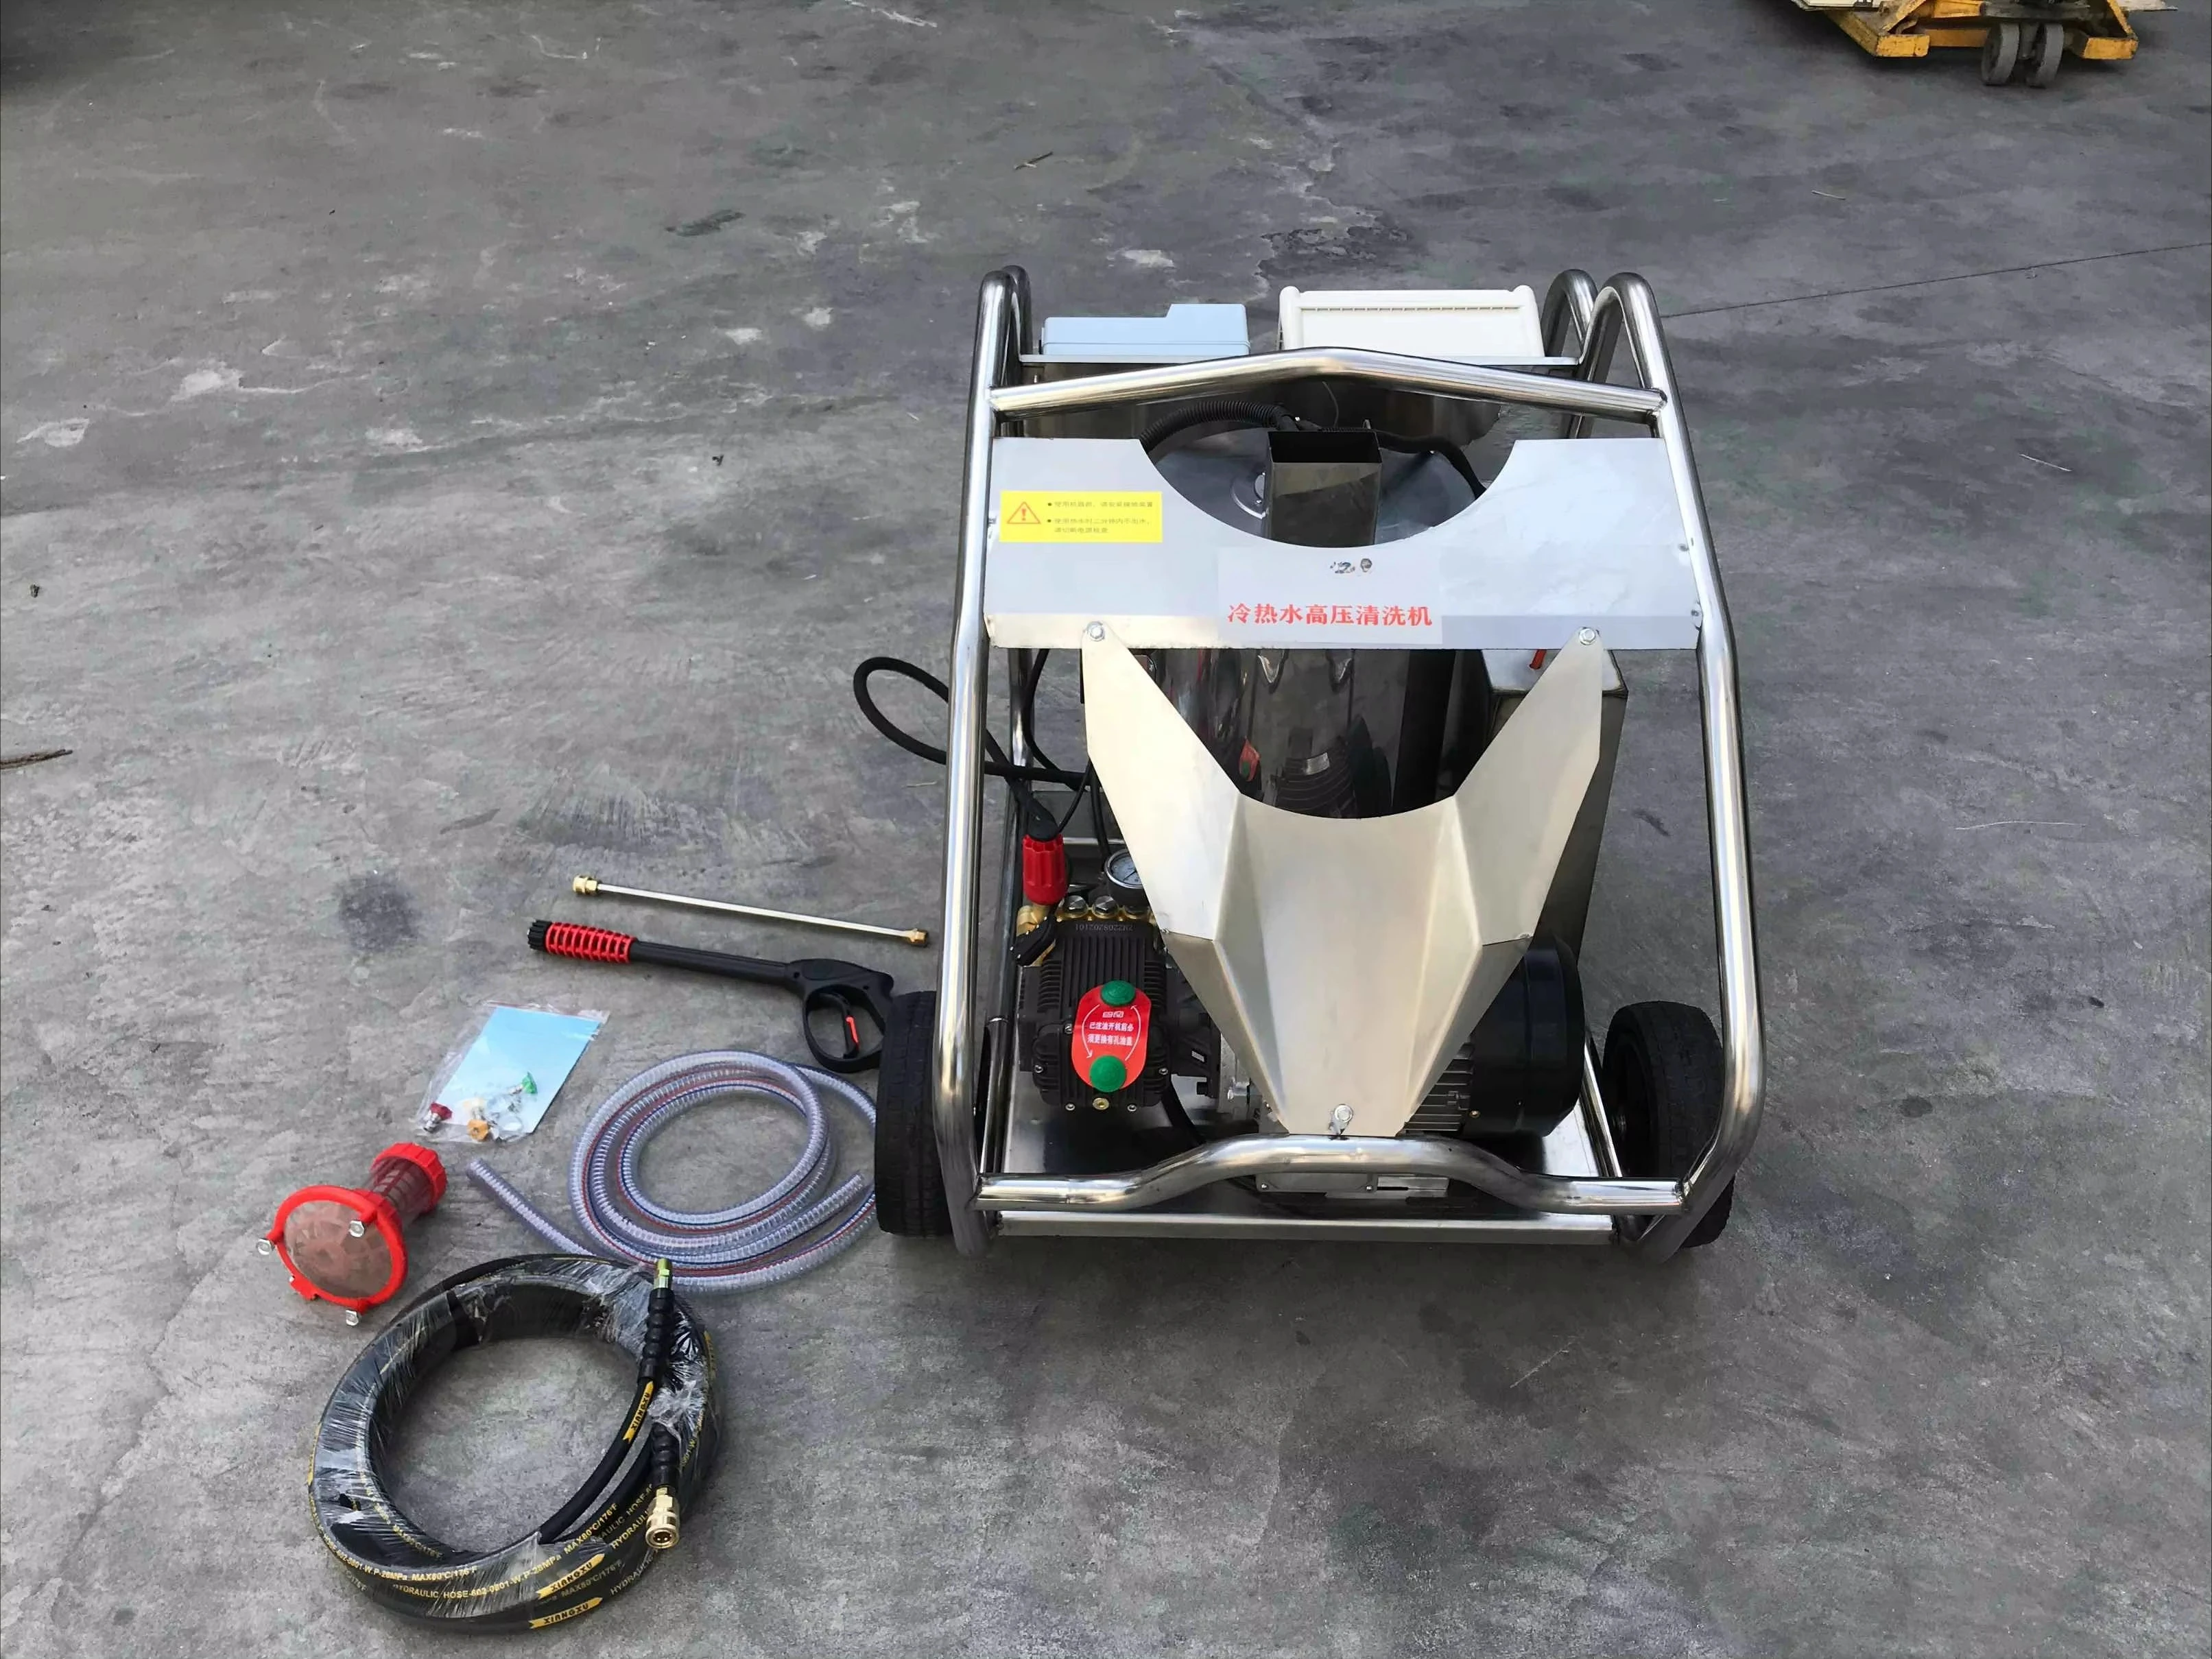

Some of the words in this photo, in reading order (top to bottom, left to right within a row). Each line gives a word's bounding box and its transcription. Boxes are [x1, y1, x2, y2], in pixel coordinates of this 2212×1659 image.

[1227, 603, 1433, 626] 冷热水高压清洗机
[630, 1392, 650, 1431] XIANGXU
[610, 1509, 648, 1549] HYDRAULI
[550, 1562, 593, 1592] XIANGXU
[543, 1603, 589, 1625] XIANGXU
